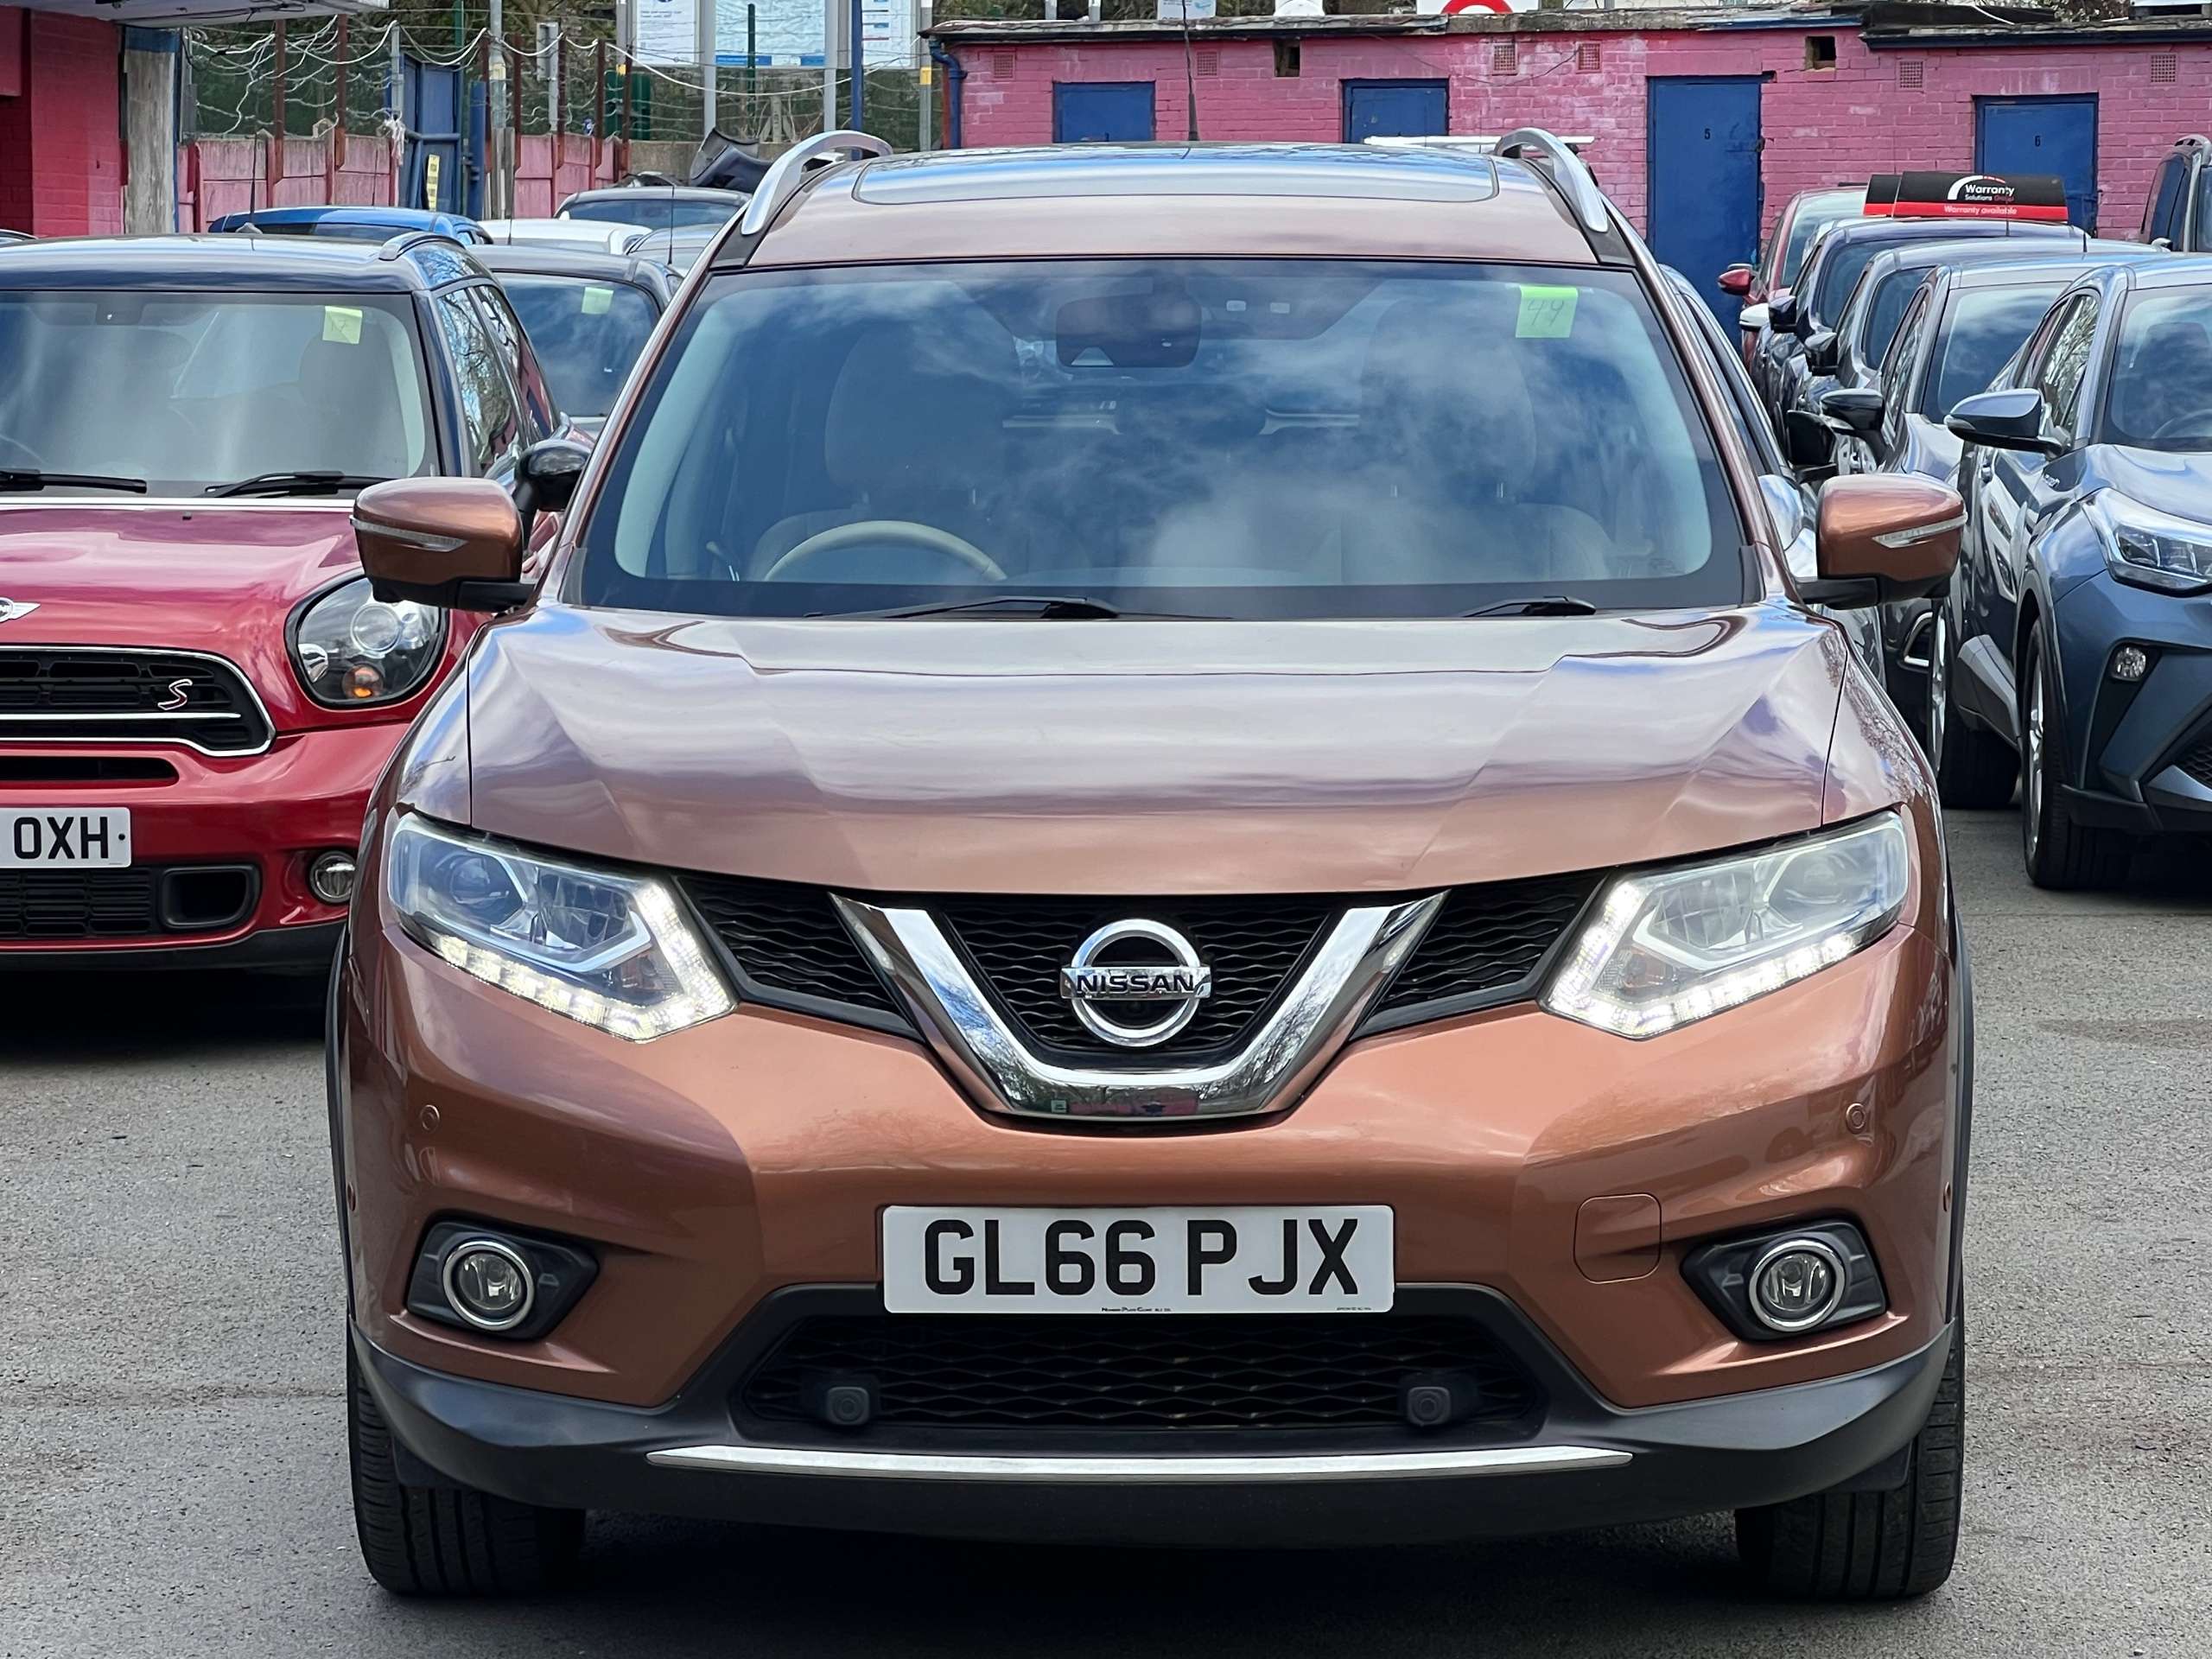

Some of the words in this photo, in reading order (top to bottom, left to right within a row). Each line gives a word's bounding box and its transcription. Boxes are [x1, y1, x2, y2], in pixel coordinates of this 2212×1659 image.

[1704, 128, 1711, 140] 5
[1965, 184, 2015, 196] Warranty
[1944, 205, 1980, 215] Warranty
[157, 678, 194, 710] S
[14, 817, 109, 860] OXH
[1077, 974, 1194, 993] NISSAN
[924, 1219, 1156, 1296] GL66
[1186, 1218, 1358, 1296] PJX
